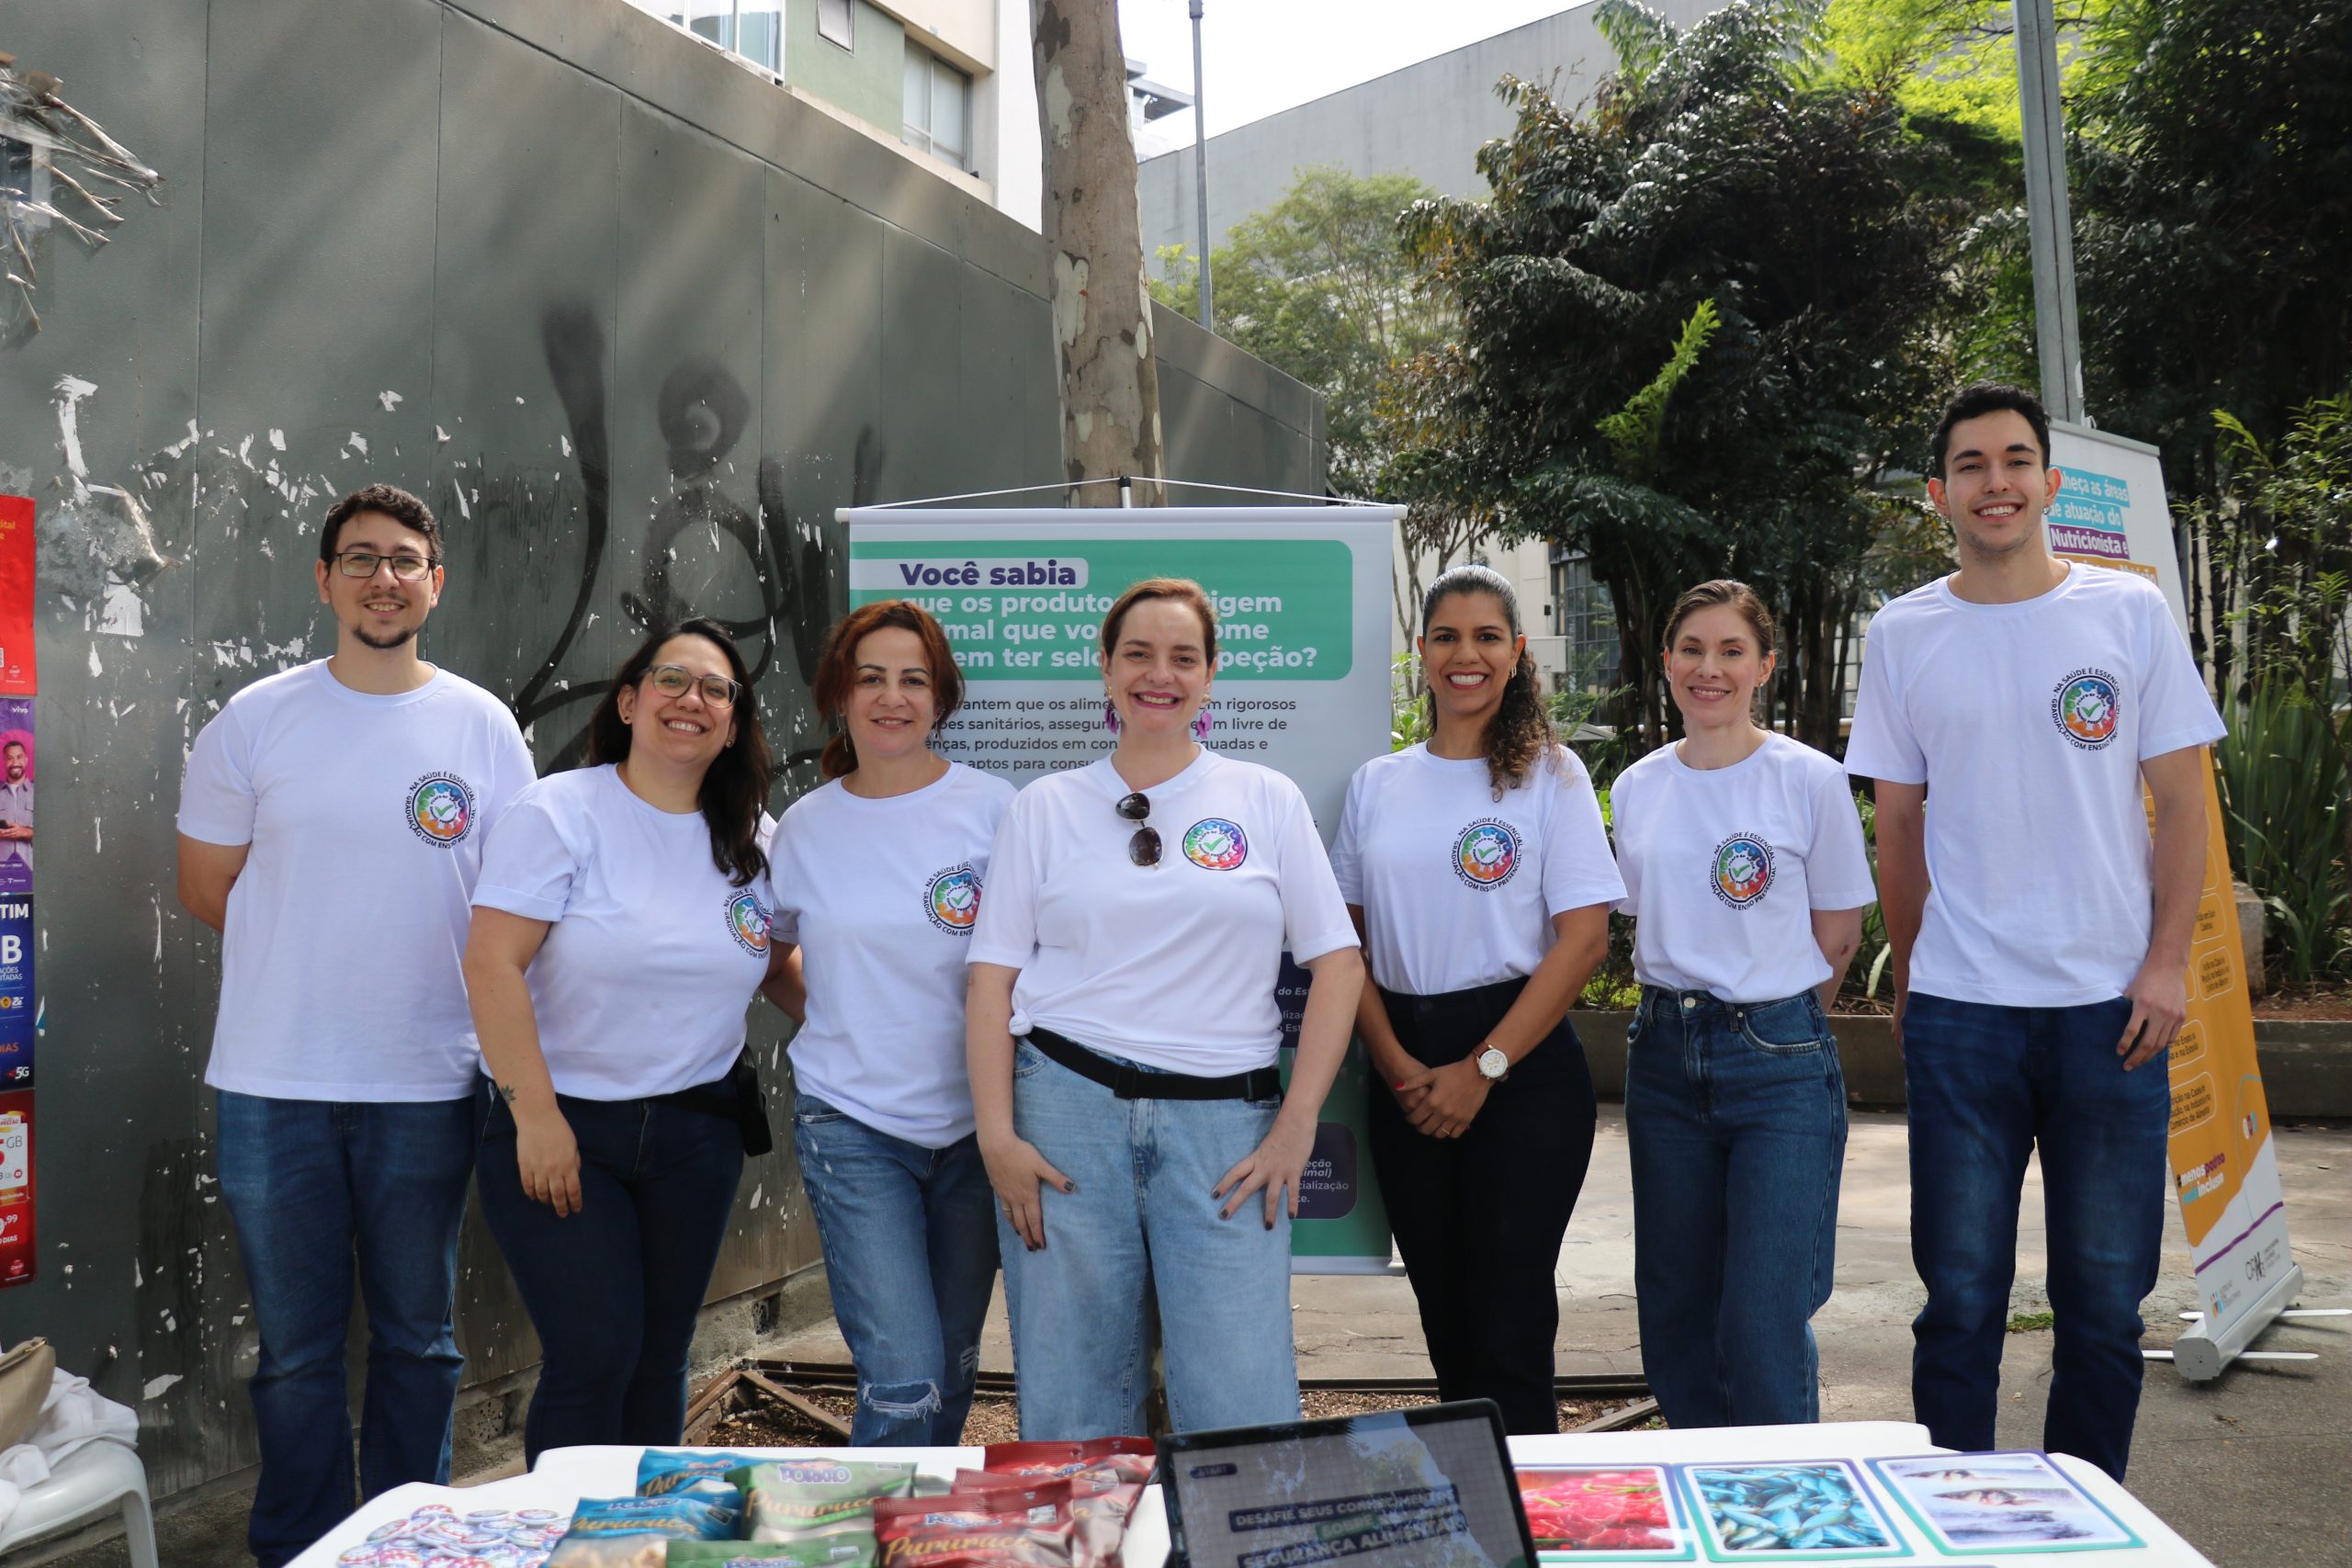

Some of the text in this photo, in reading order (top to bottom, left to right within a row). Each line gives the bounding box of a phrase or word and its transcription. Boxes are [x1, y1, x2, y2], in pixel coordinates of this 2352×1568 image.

[2062, 471, 2129, 502] heça as áreas
[2064, 502, 2105, 525] atuação
[2108, 507, 2121, 526] do
[2050, 528, 2121, 554] Nutricionista
[899, 559, 1076, 585] Você sabia
[961, 596, 992, 613] os
[1211, 590, 1282, 617] igem
[1003, 624, 1056, 645] que
[1065, 624, 1101, 640] vo
[1214, 624, 1269, 639] ome
[1002, 648, 1043, 667] ter
[1217, 646, 1317, 672] peção?
[2053, 683, 2064, 694] NA
[2062, 669, 2086, 682] SAÚDE
[964, 700, 1011, 710] antem
[1016, 700, 1044, 712] que
[1048, 700, 1065, 710] os
[1070, 698, 1109, 710] alime
[1227, 698, 1296, 713] rigorosos
[968, 717, 1044, 731] sanitários,
[1232, 718, 1264, 729] livre
[1268, 718, 1287, 729] de
[2051, 698, 2070, 740] GRADUAÇÃO
[2070, 739, 2086, 750] COM
[926, 737, 970, 751] enças,
[975, 738, 1057, 751] produzidos
[1062, 739, 1085, 750] em
[1200, 739, 1255, 750] quadas
[1260, 740, 1268, 750] e
[1013, 759, 1045, 772] para
[1050, 758, 1094, 769] consu
[410, 782, 420, 792] NA
[419, 772, 441, 783] SAÚDE
[449, 773, 476, 802] ESSENCIAL
[405, 795, 422, 837] GRADUAÇÃO
[422, 835, 436, 847] COM
[458, 808, 476, 843] PRESENCIAL
[1458, 827, 1468, 836] NA
[1468, 818, 1491, 827] SAÚDE
[1498, 819, 1523, 847] ESSENCIAL
[1714, 844, 1721, 855] NA
[1722, 832, 1743, 844] SAÚDE
[1750, 833, 1775, 861] ESSENCIAL
[926, 877, 934, 887] NA
[933, 865, 956, 877] SAÚDE
[1452, 840, 1464, 881] GRADUAÇÃO
[1464, 880, 1478, 890] COM
[1498, 853, 1521, 887] PRESENCIAL
[1710, 861, 1724, 900] GRADUAÇÃO
[1724, 899, 1736, 909] COM
[1755, 866, 1776, 903] PRESENCIAL
[0, 904, 28, 919] TIM
[923, 891, 942, 929] GRADUAÇÃO
[942, 926, 957, 936] COM
[725, 911, 746, 949] GRADUAÇÃO
[745, 947, 758, 958] COM
[1278, 987, 1292, 995] do
[15, 1066, 29, 1079] 5G
[6, 1135, 23, 1148] GB
[1304, 1168, 1331, 1179] imal)
[1307, 1158, 1331, 1169] eção
[1300, 1180, 1349, 1192] ialização
[1236, 1510, 1295, 1525] DESAFIE
[1299, 1505, 1333, 1518] SEUS
[1321, 1517, 1374, 1539] SOBRE
[885, 1535, 1035, 1566] Pururuca
